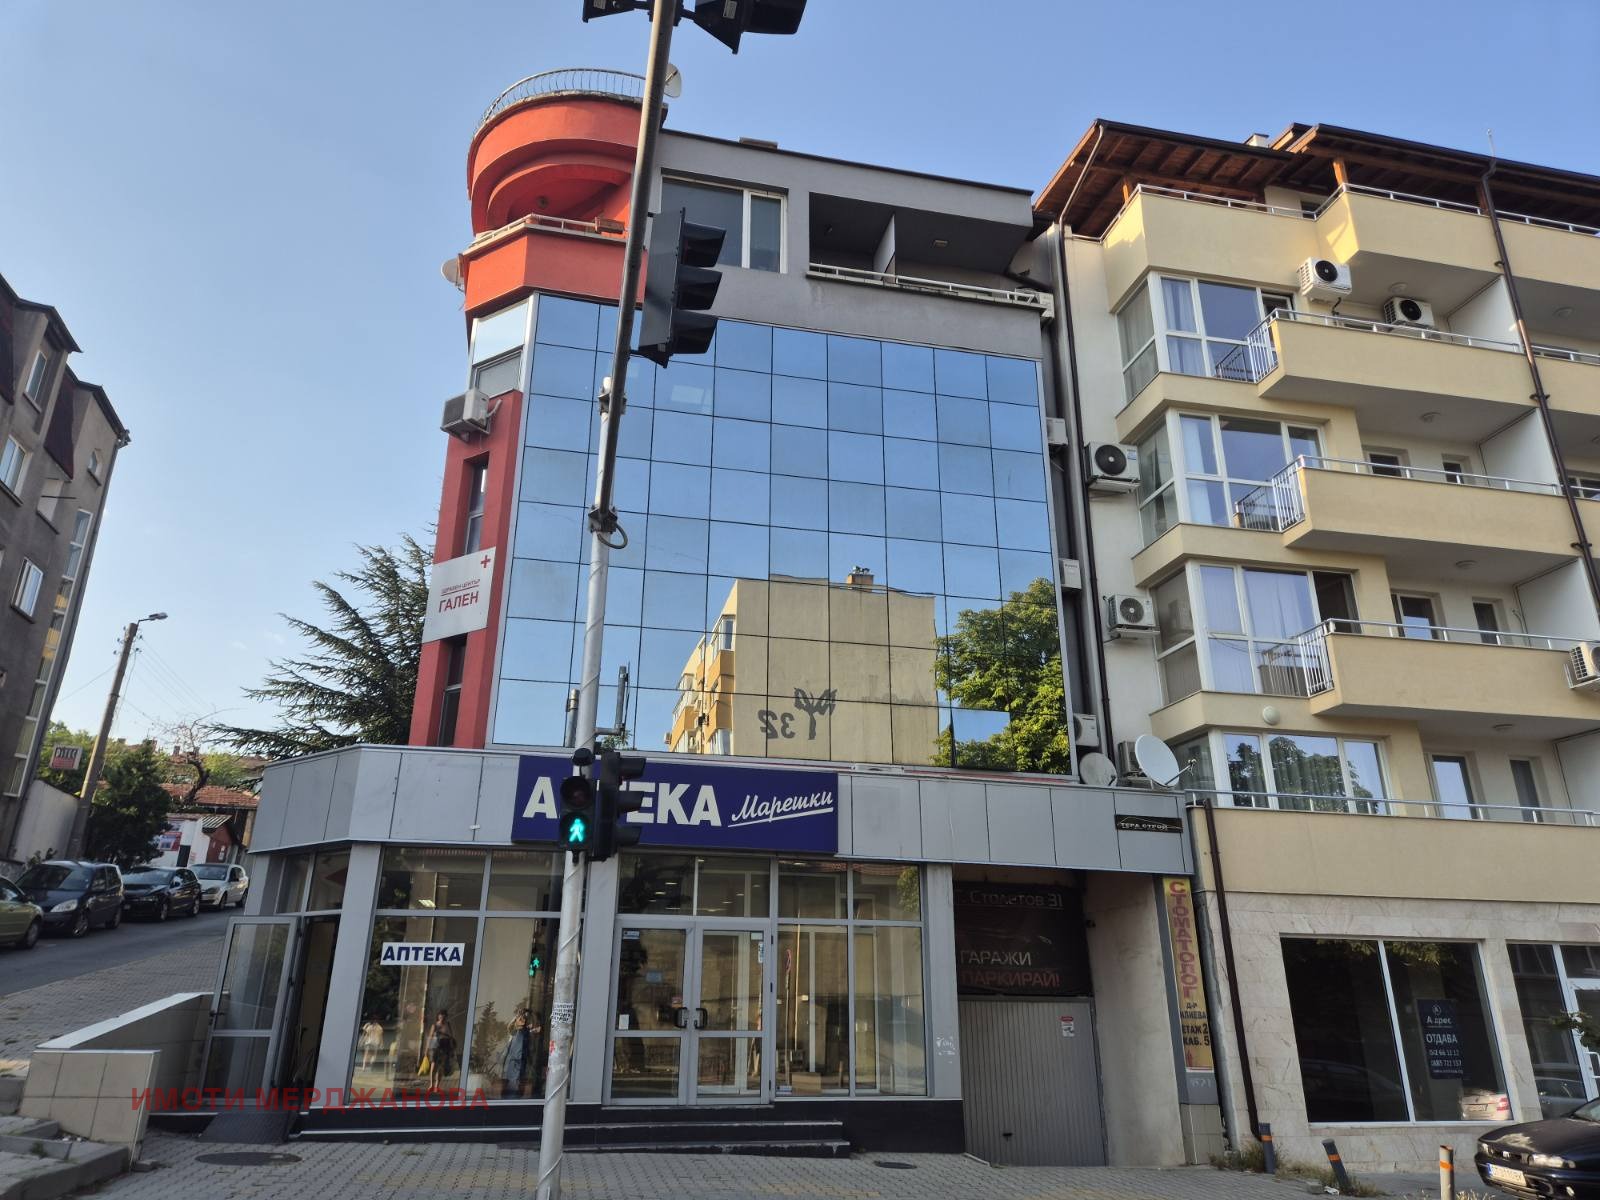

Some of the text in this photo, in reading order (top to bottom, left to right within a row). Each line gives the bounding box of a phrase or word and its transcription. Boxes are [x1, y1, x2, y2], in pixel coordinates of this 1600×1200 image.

[438, 591, 479, 613] ГАЛЕН
[522, 776, 834, 827] АЕКА Марешки
[1048, 893, 1064, 907] 31
[1169, 881, 1199, 999] СТОМАТОЛОГ
[382, 945, 461, 962] АПТЕКА
[960, 950, 1032, 966] ГАРАЖИ
[960, 969, 1061, 988] ПАРКИРАЙ!
[1182, 1023, 1209, 1035] ЕТАЖ 2
[1203, 1036, 1210, 1046] 5
[1426, 1033, 1458, 1045] ОТДАВА
